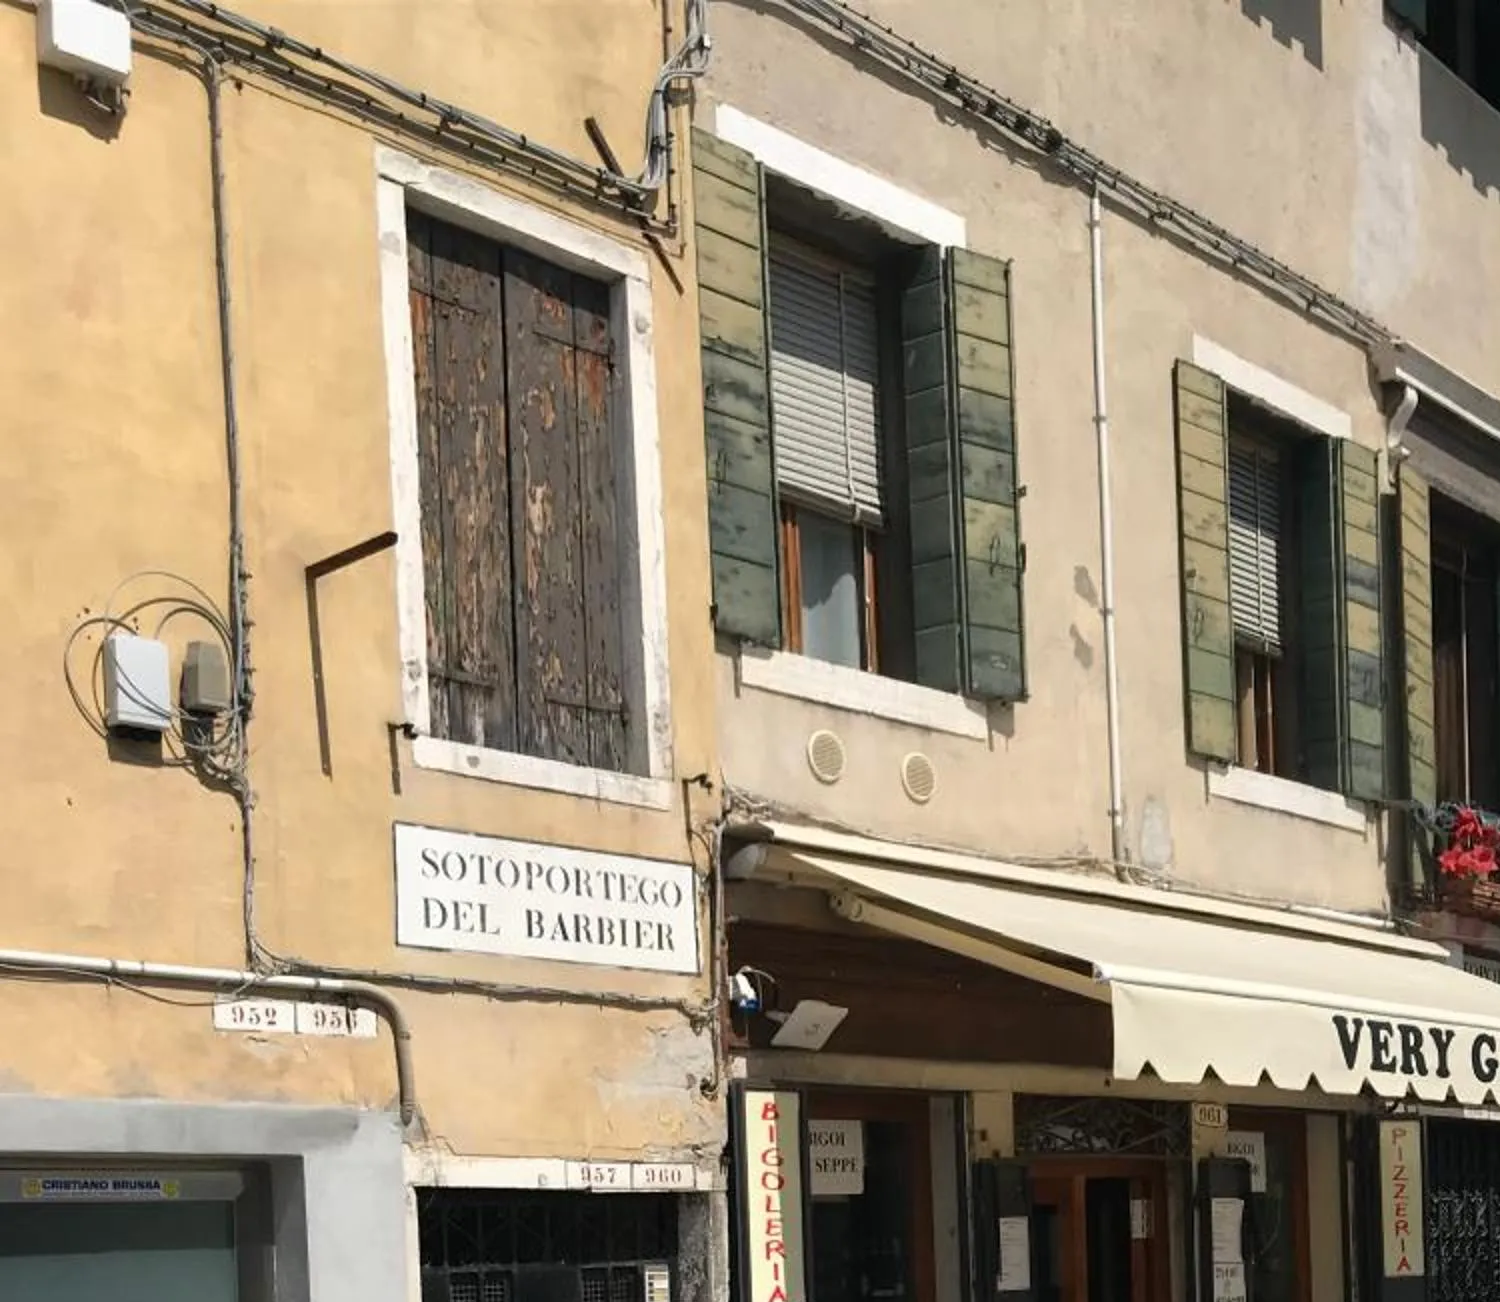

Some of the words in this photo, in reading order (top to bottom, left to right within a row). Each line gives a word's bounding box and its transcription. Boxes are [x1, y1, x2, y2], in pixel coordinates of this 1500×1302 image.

[420, 848, 682, 908] SOTOPORTEGO
[422, 896, 500, 935] DEL
[525, 908, 675, 952] BARBIER
[231, 1006, 277, 1026] 952
[1332, 1014, 1454, 1078] VERY
[580, 1167, 616, 1184] 957
[645, 1167, 682, 1184] 960
[1391, 1127, 1411, 1272] PIZZERIA
